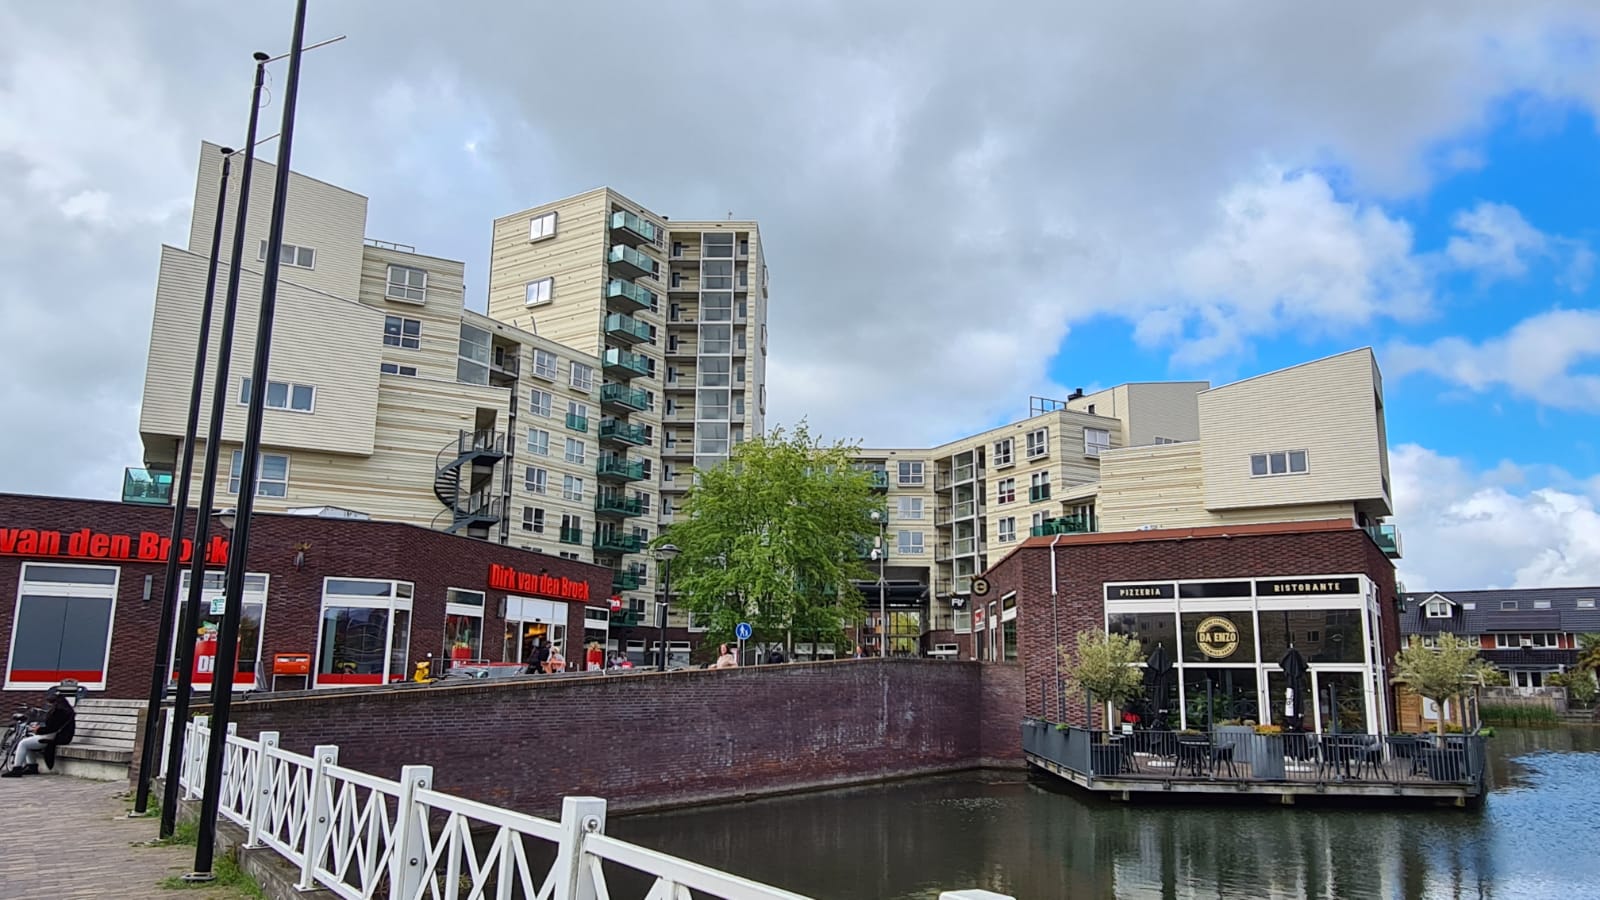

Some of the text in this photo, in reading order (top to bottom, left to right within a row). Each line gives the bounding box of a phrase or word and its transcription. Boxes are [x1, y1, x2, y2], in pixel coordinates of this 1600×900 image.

[0, 528, 229, 563] van den Brok
[491, 563, 589, 600] Dirk van den Broek
[1273, 582, 1340, 592] RISTORANTE
[1120, 588, 1161, 597] PIZZERIA
[1200, 632, 1236, 642] DA ENZO
